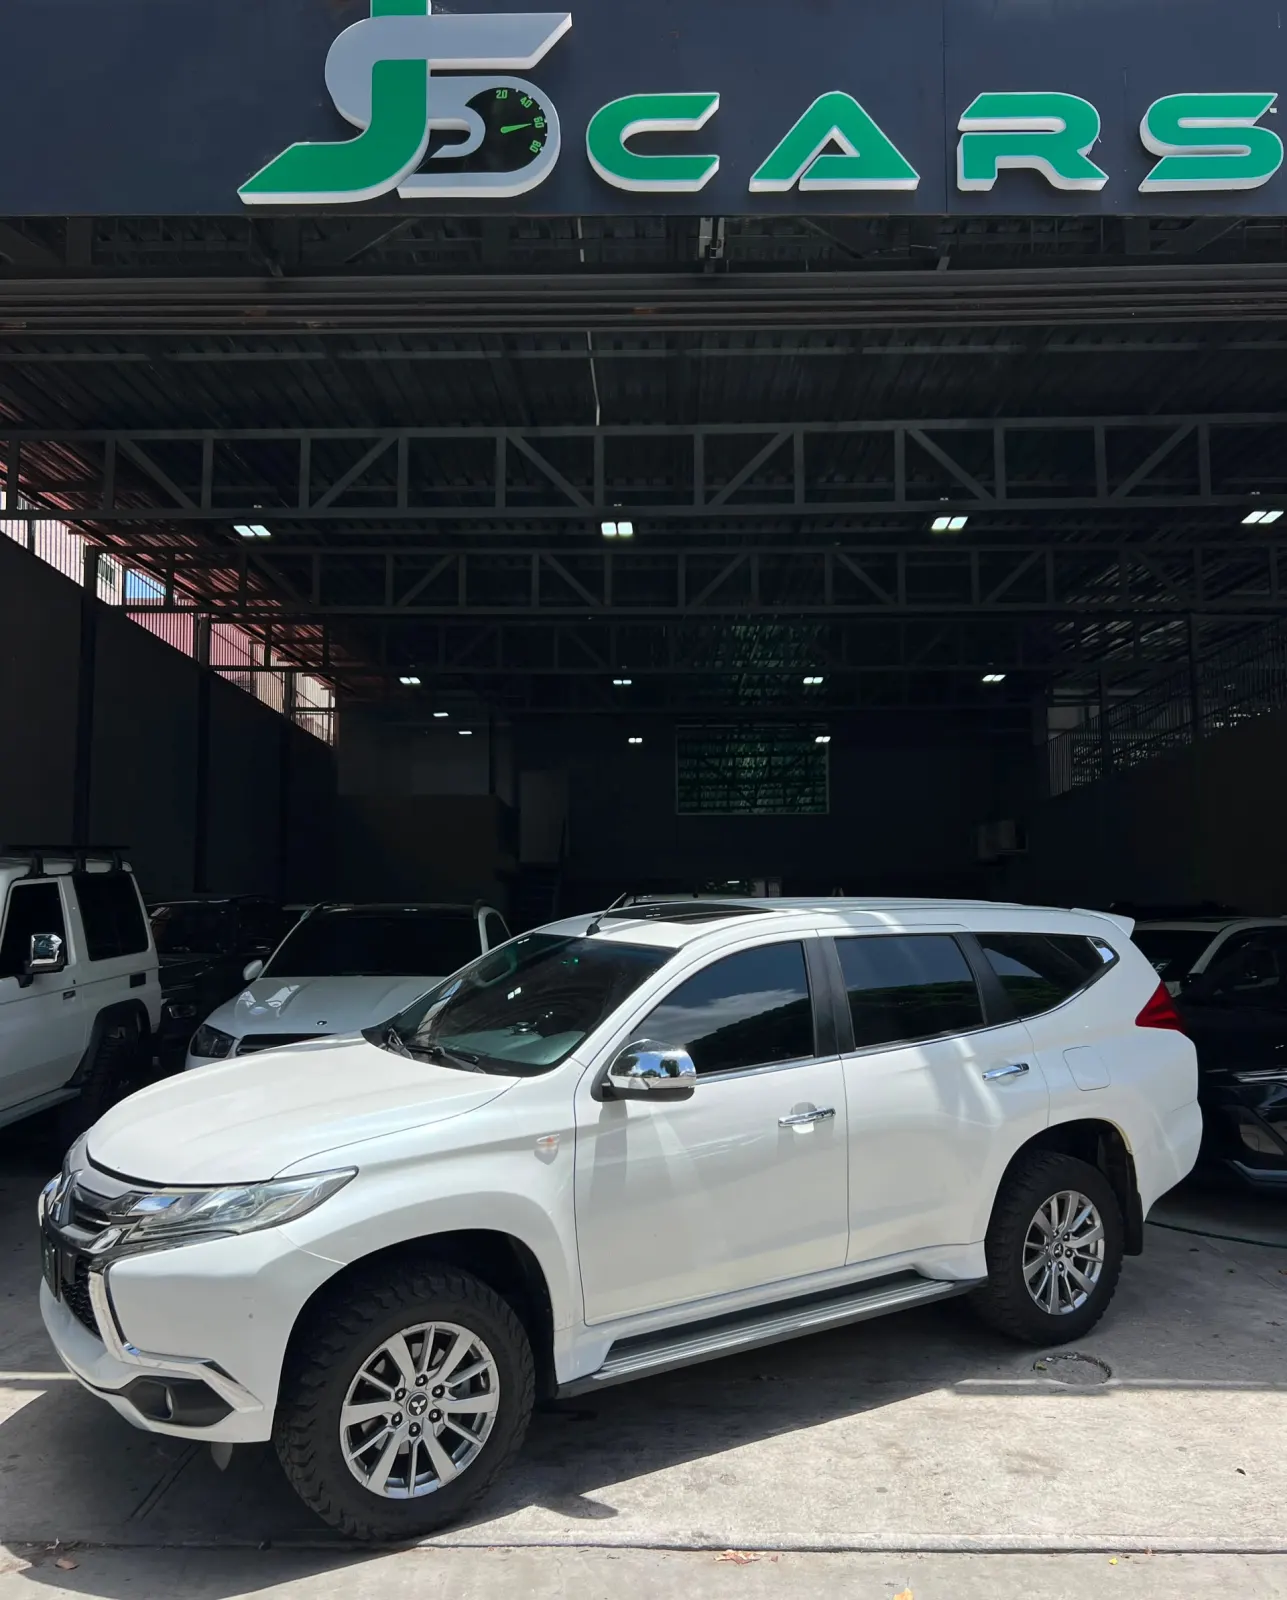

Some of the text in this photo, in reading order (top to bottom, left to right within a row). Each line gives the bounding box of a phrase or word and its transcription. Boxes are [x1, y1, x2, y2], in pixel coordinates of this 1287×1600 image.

[495, 89, 508, 99] 20
[519, 96, 533, 109] 40
[533, 116, 545, 129] 60
[586, 90, 1284, 193] CARS
